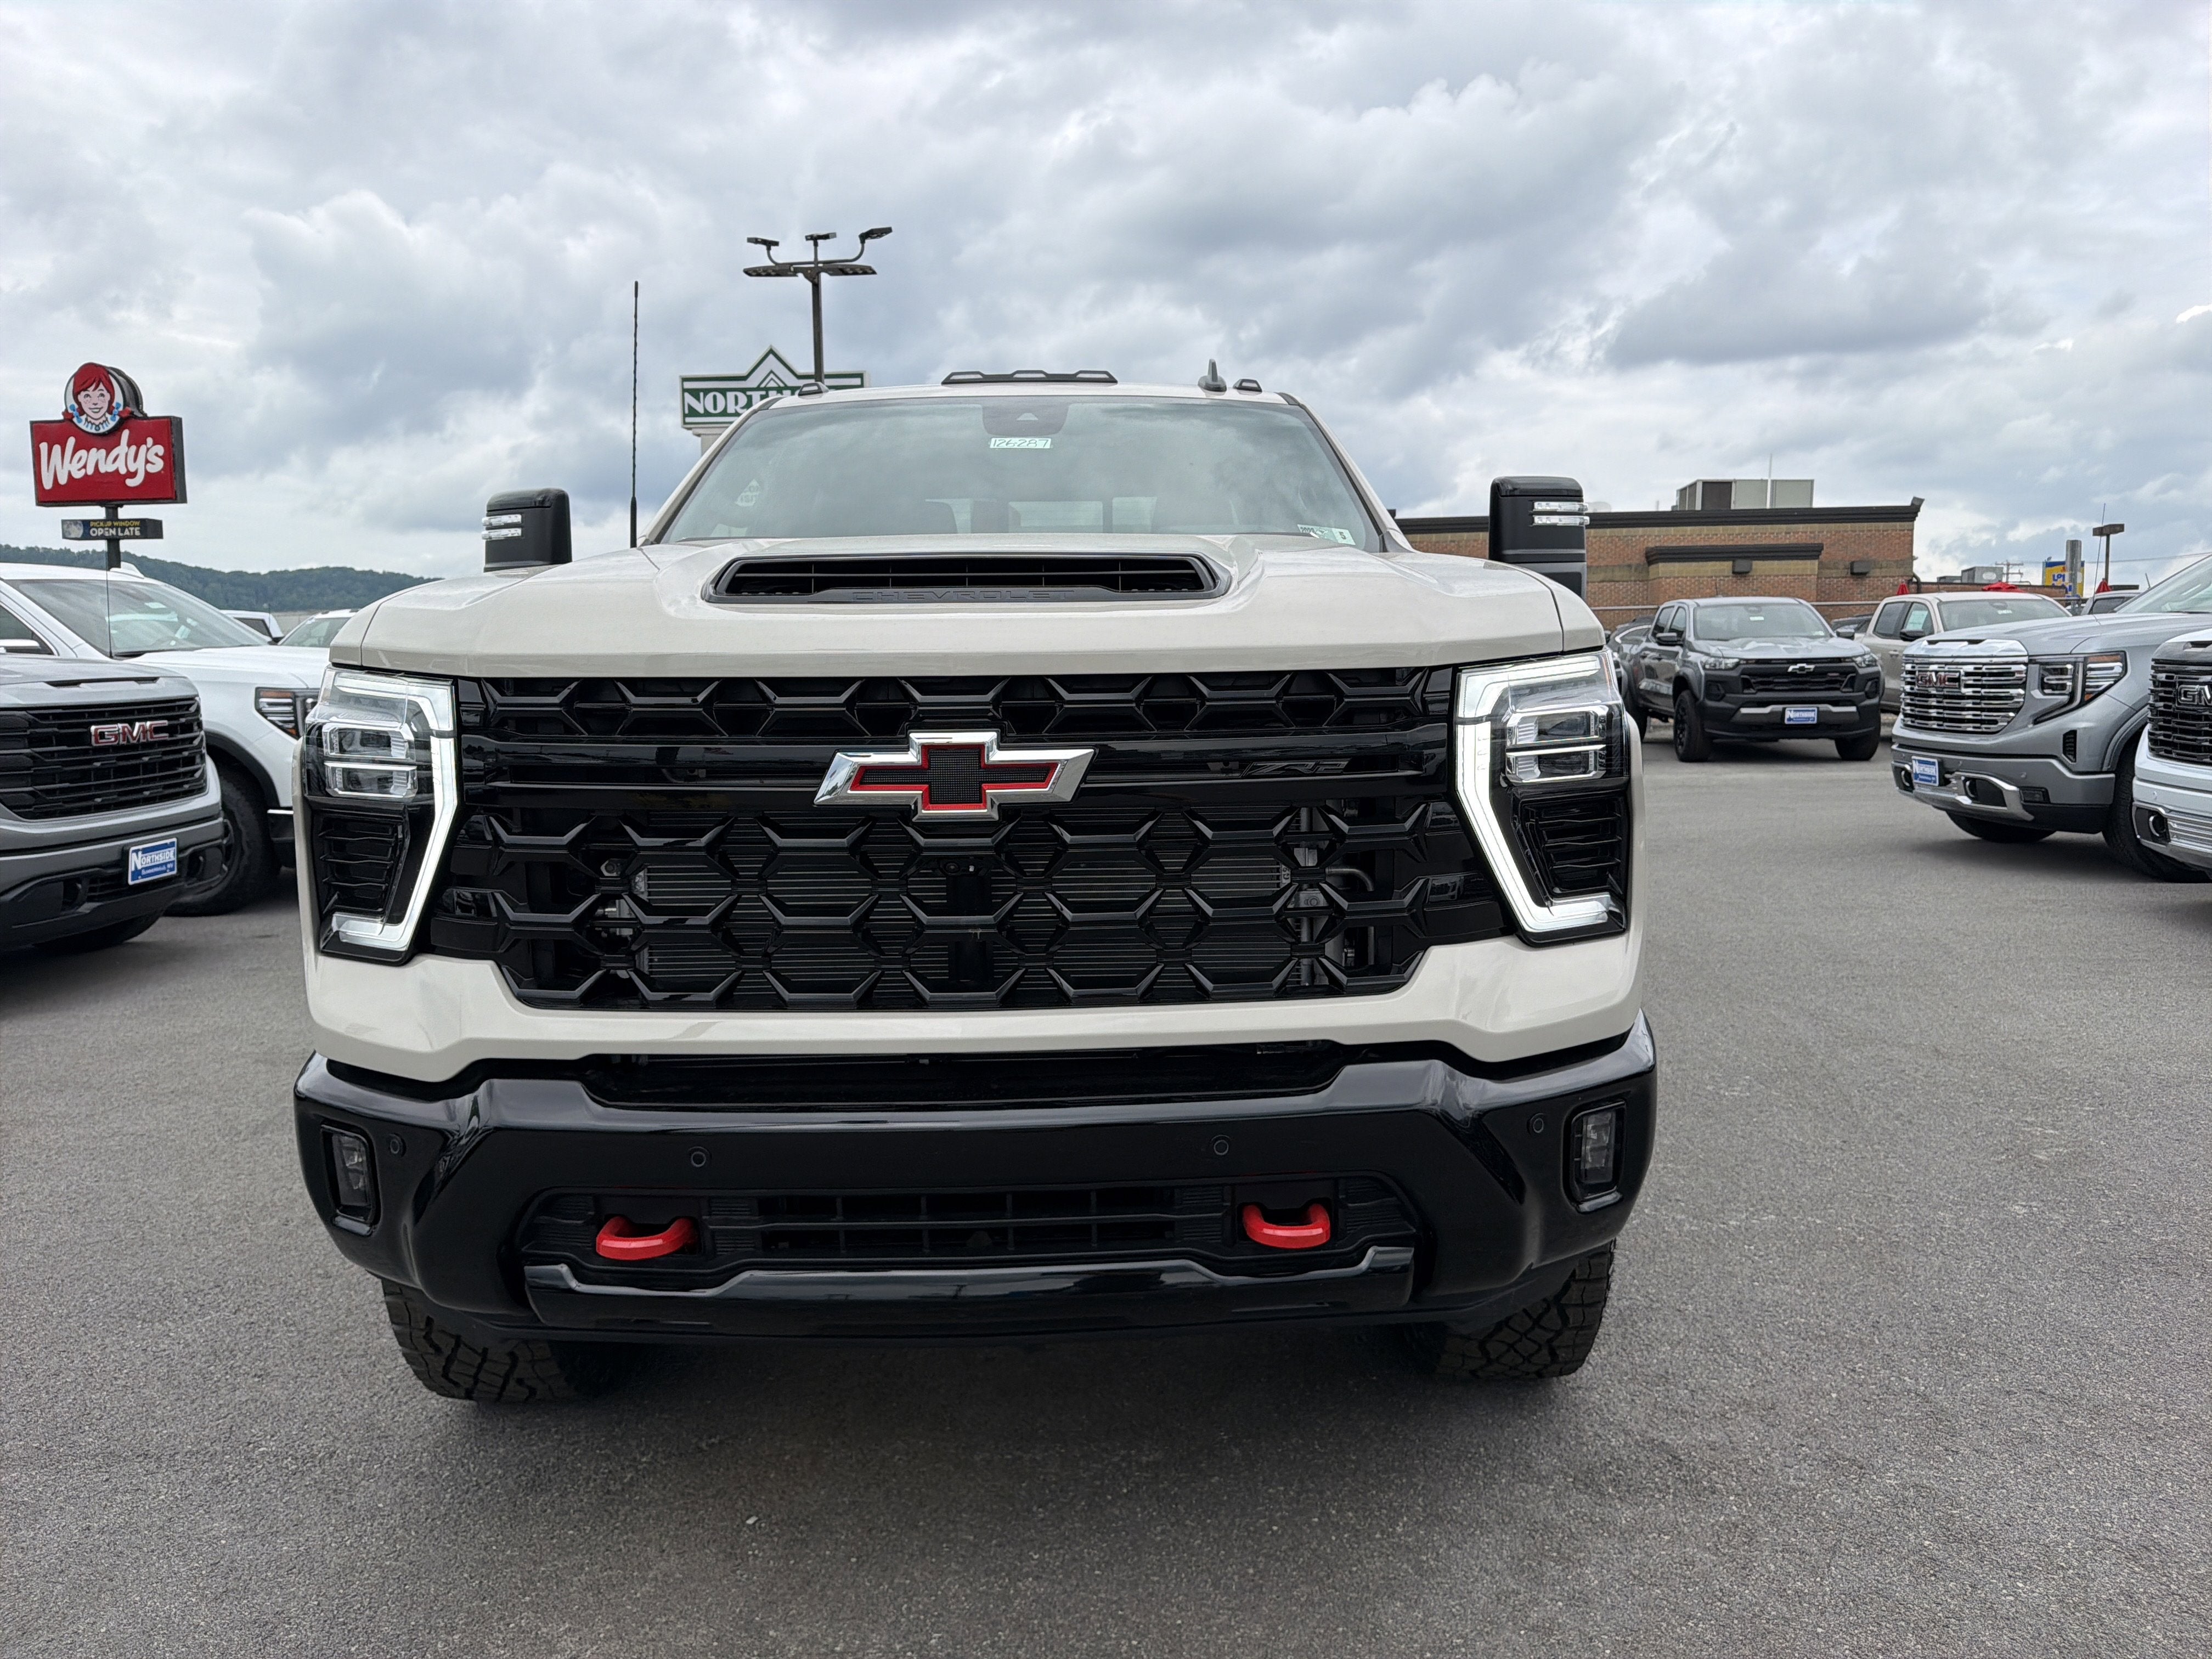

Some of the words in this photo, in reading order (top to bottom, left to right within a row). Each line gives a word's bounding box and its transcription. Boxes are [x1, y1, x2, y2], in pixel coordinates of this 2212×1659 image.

[684, 390, 800, 414] NORT
[39, 428, 165, 490] Wendy's
[89, 527, 116, 537] OPEN
[118, 527, 141, 536] LATE
[1338, 531, 1347, 540] 5
[852, 590, 1075, 601] CHEVROLET
[1918, 671, 1960, 688] GMC
[91, 720, 169, 746] GMC
[132, 850, 175, 872] NORTHSIDE
